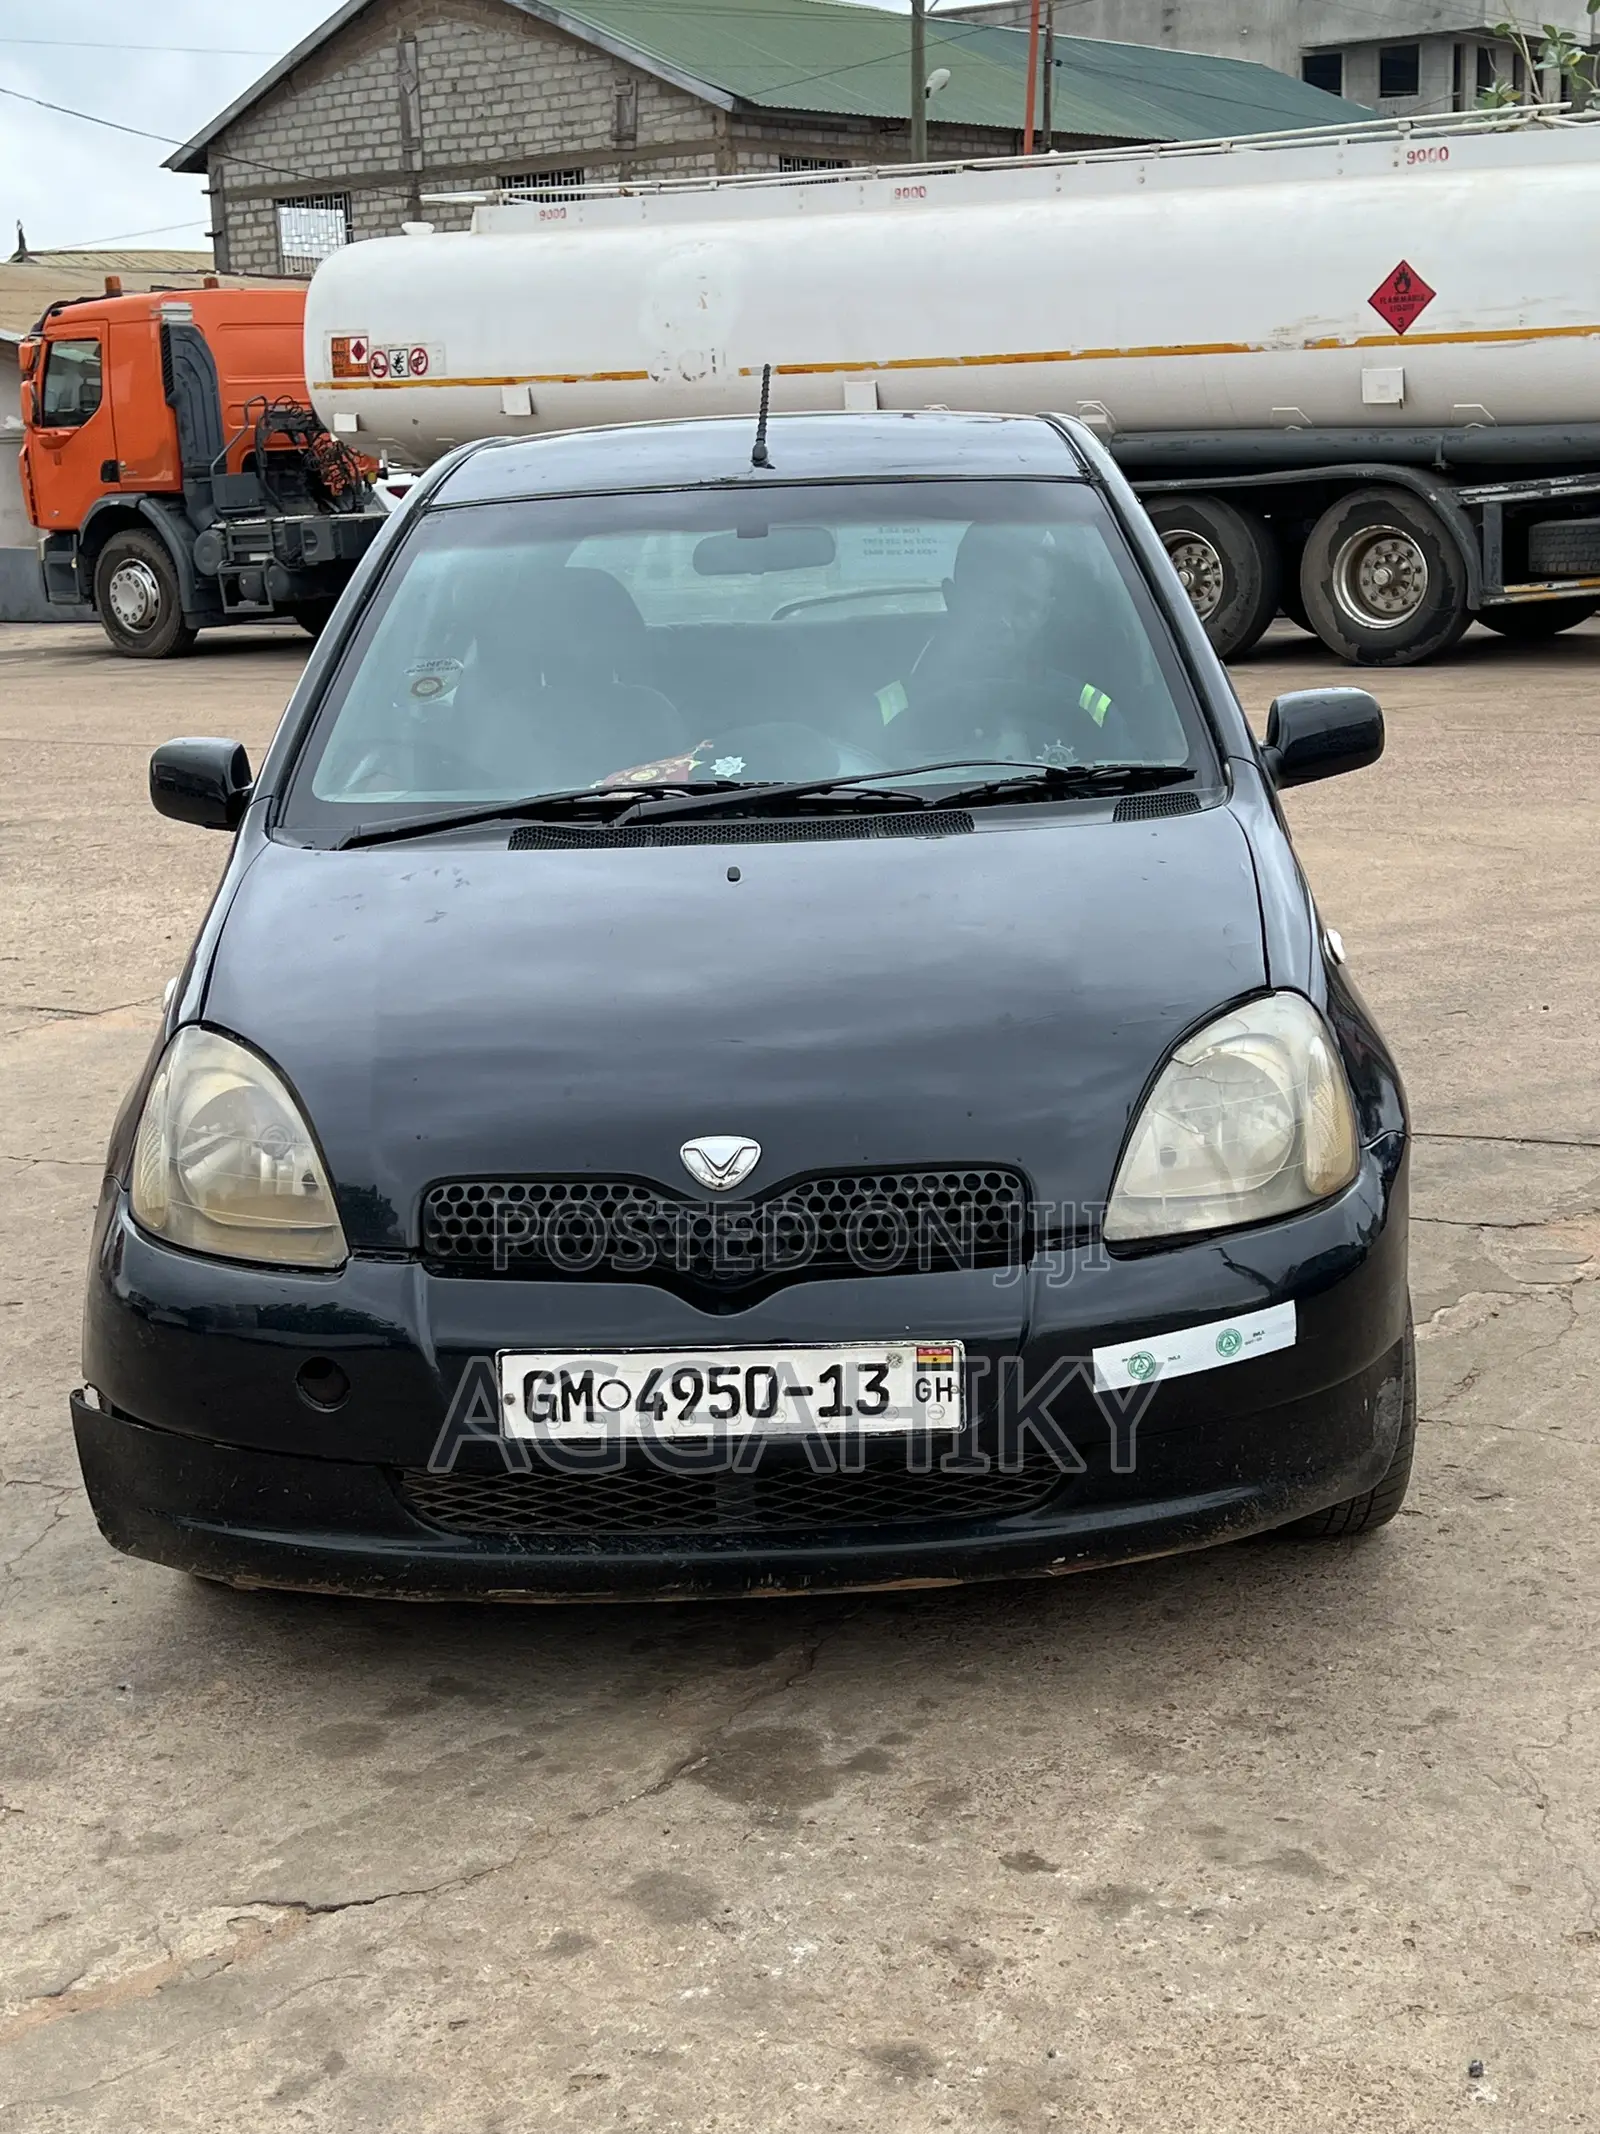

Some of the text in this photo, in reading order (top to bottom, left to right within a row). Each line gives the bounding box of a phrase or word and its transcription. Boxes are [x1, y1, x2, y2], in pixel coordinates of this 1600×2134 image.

[1407, 146, 1449, 165] 9000
[894, 185, 927, 200] 9000
[1397, 316, 1405, 328] 3
[523, 1362, 890, 1423] GM 4950-13
[914, 1376, 954, 1403] GH
